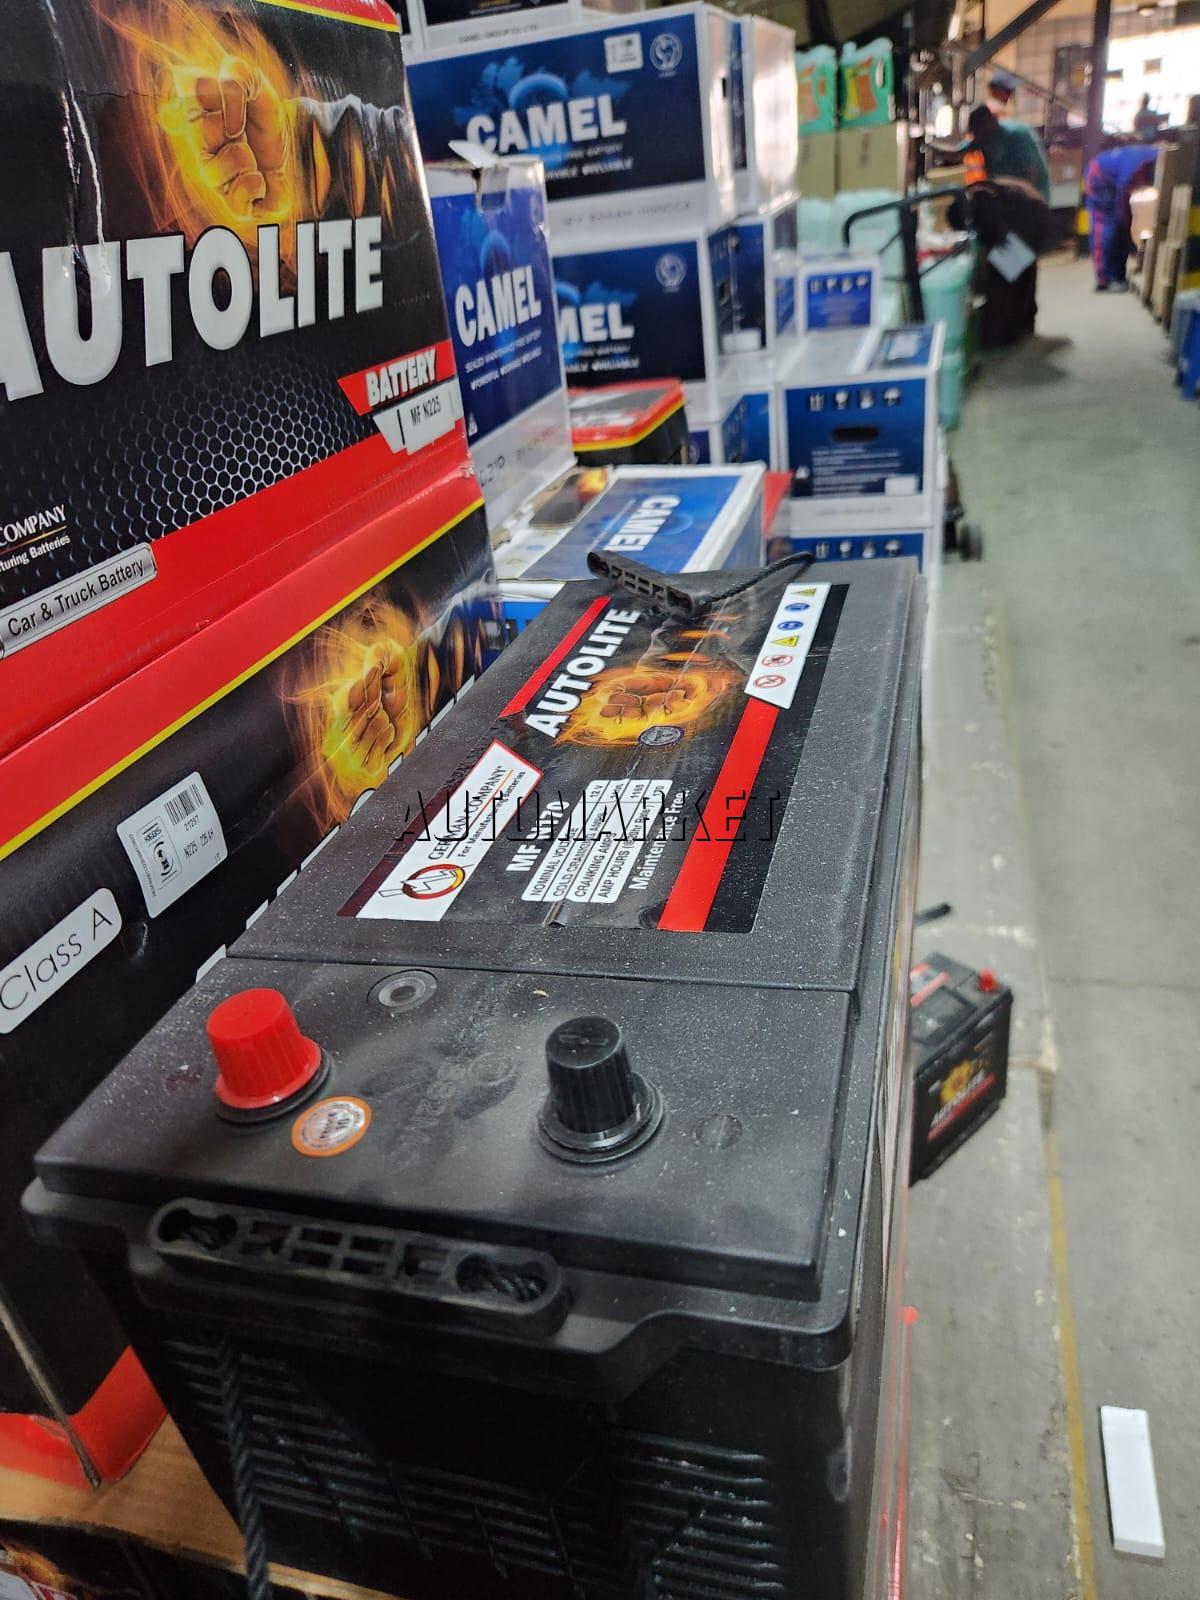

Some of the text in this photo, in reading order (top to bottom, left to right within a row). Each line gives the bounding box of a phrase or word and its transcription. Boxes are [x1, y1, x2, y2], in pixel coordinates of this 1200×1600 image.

[466, 94, 627, 155] CAMEL
[455, 265, 542, 347] CAMEL
[365, 347, 436, 407] BATTERY
[410, 396, 442, 425] MF N225
[29, 533, 71, 559] Batteries
[8, 559, 144, 637] Car & Truck Battery
[524, 607, 643, 739] AUTOLITE
[457, 842, 471, 858] For
[506, 800, 570, 873] MF N170
[573, 855, 604, 898] CRANKING
[601, 831, 617, 857] AMPS
[628, 811, 678, 890] Maintenance
[530, 857, 558, 897] NOMINAL
[552, 869, 573, 898] COLD
[597, 874, 613, 899] AMP
[610, 849, 629, 878] HOURS
[0, 907, 114, 1012] Class A
